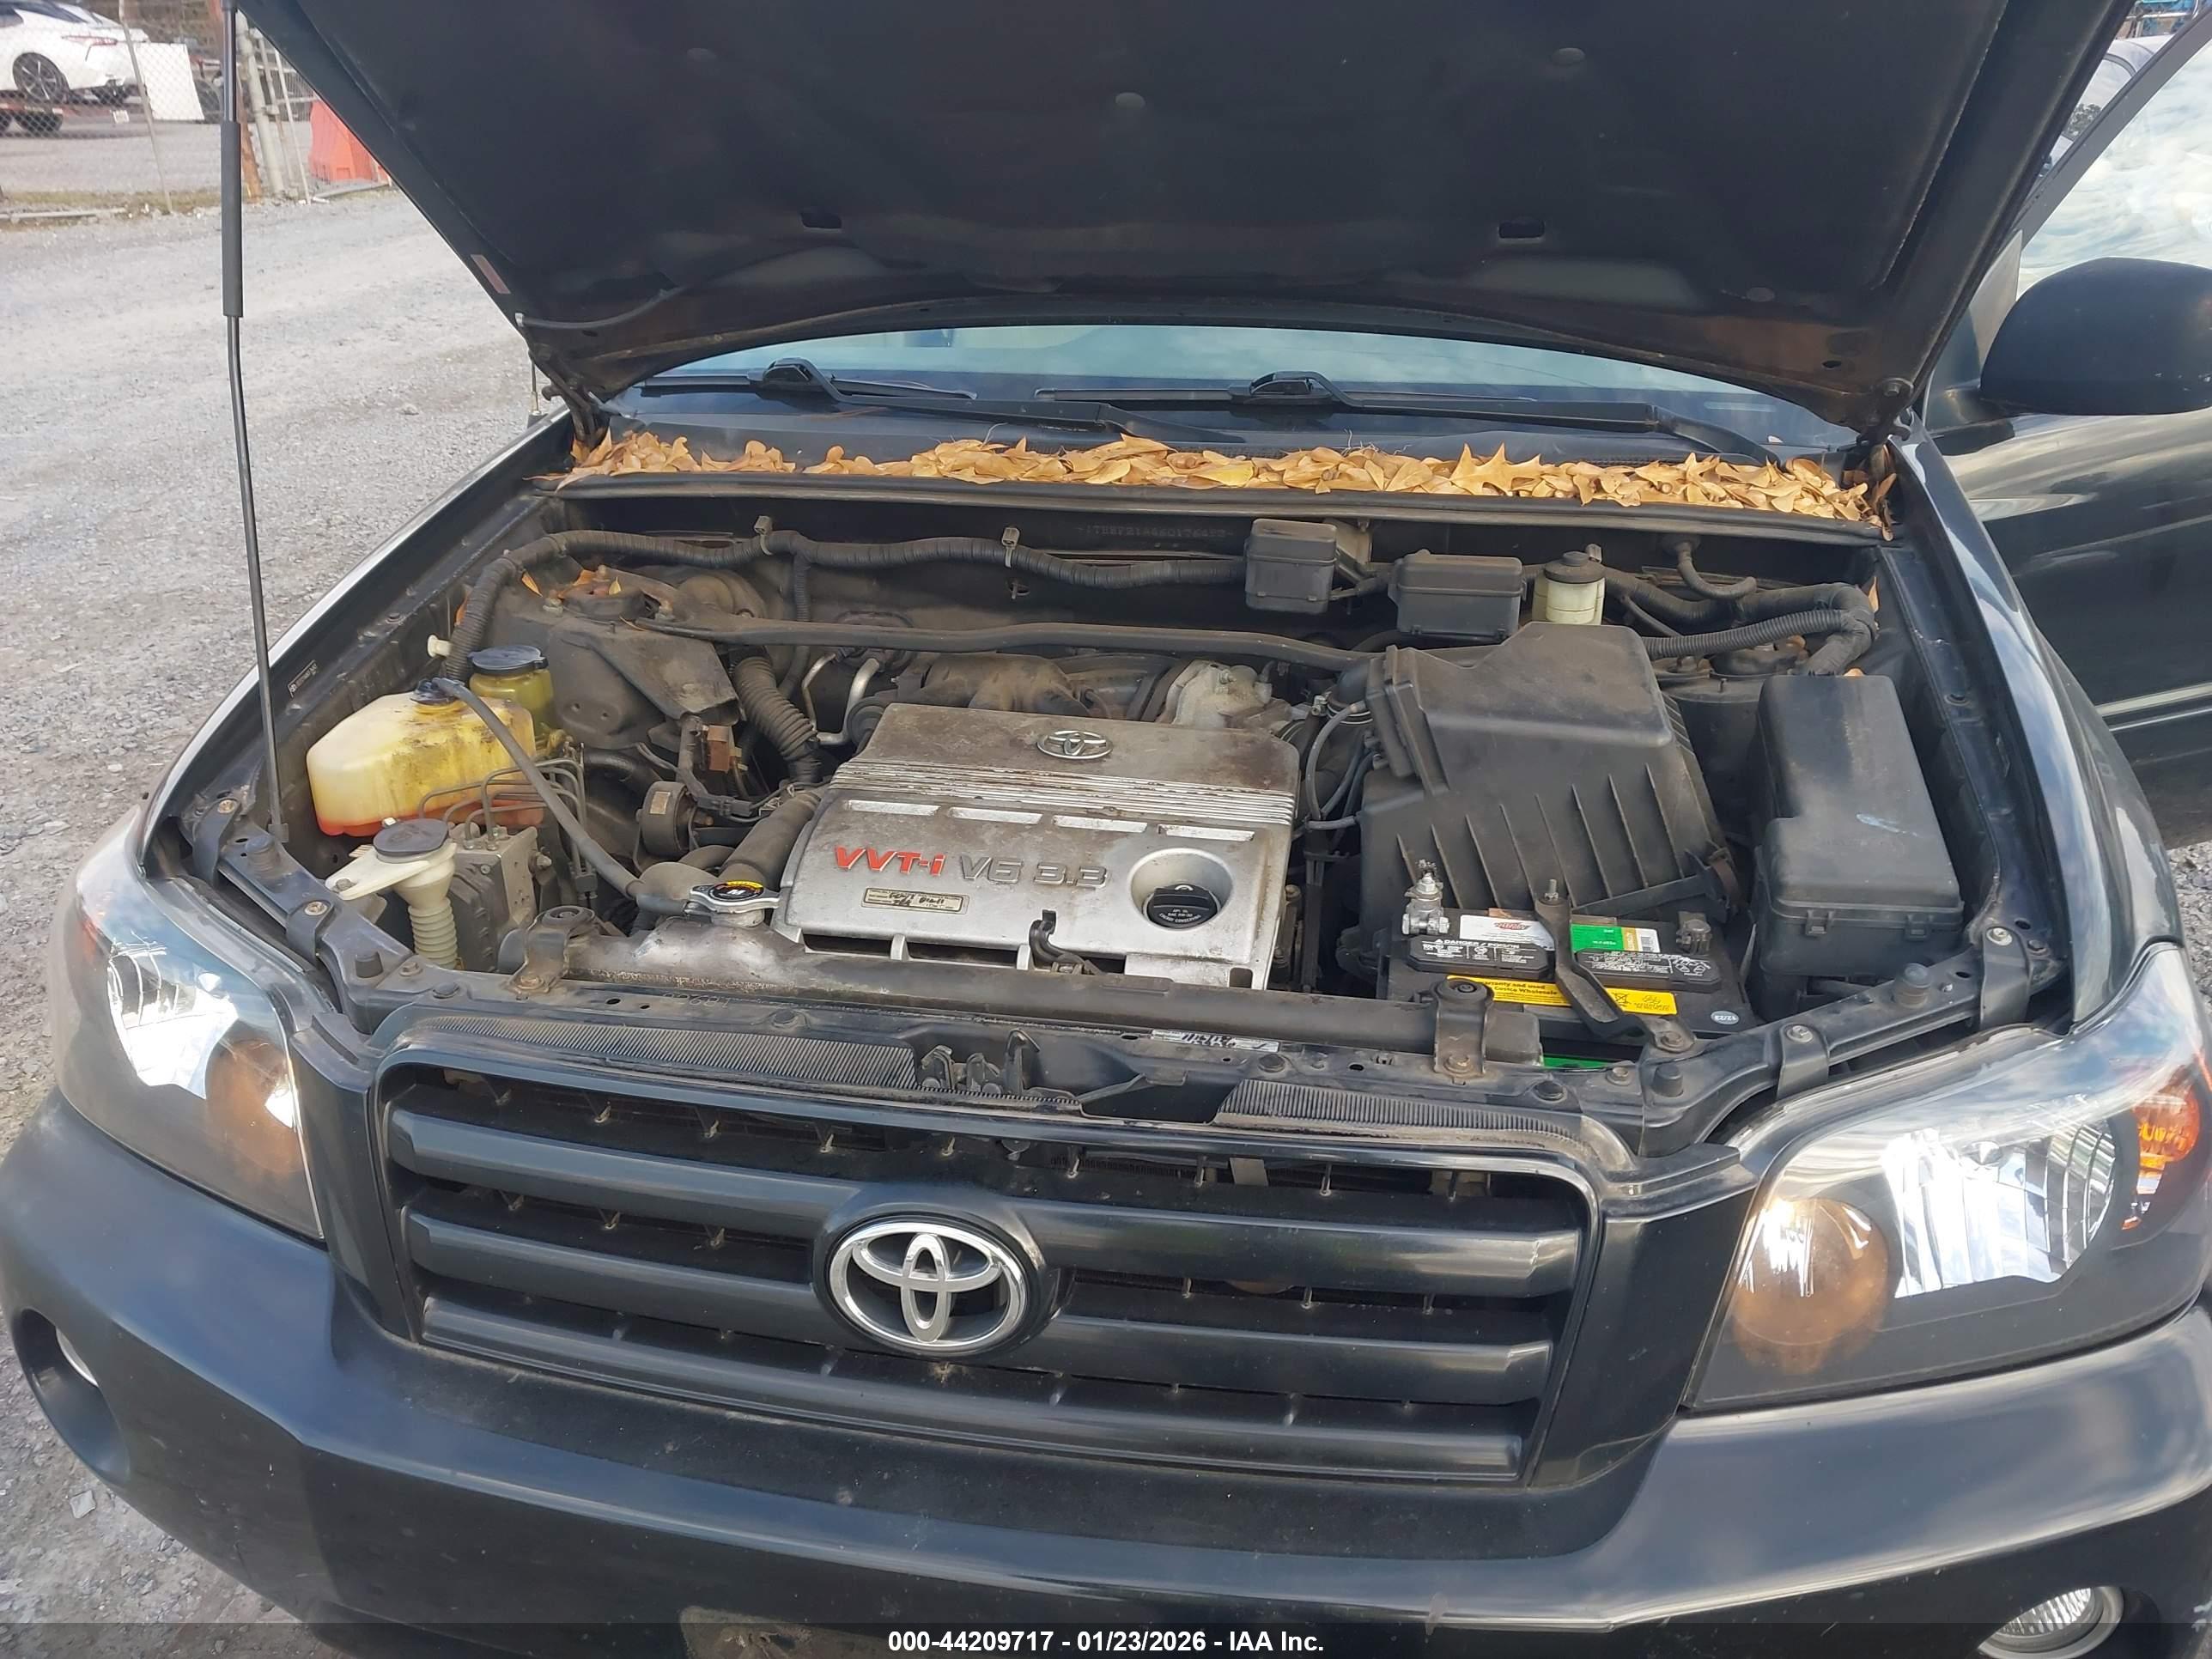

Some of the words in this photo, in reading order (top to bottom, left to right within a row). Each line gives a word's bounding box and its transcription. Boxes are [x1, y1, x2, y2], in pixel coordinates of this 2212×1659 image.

[835, 847, 945, 876] VVT-i
[960, 855, 1024, 884] V6
[1033, 861, 1108, 889] 3.3
